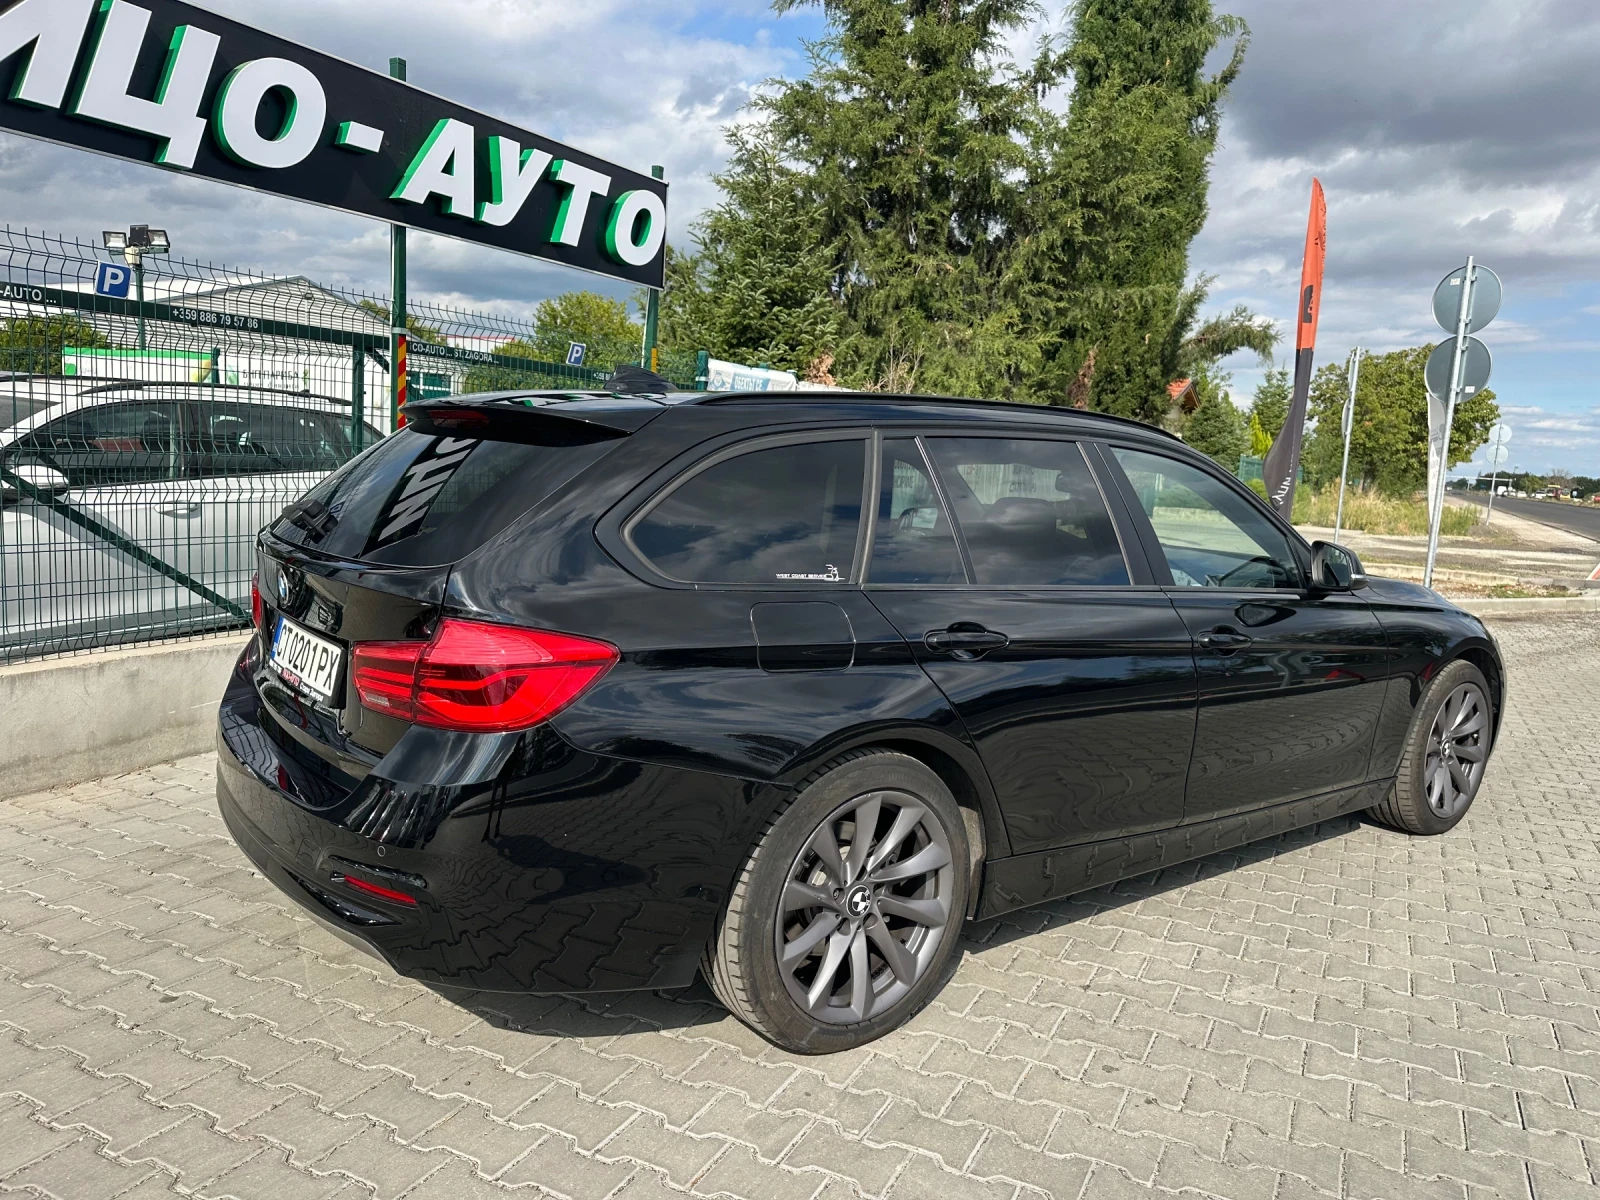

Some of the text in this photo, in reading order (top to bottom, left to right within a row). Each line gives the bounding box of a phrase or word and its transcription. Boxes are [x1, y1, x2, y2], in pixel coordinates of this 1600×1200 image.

[103, 267, 124, 292] P
[172, 307, 259, 329] +359 886 79 57 86
[464, 350, 493, 363] ZAGORA
[571, 346, 582, 363] P
